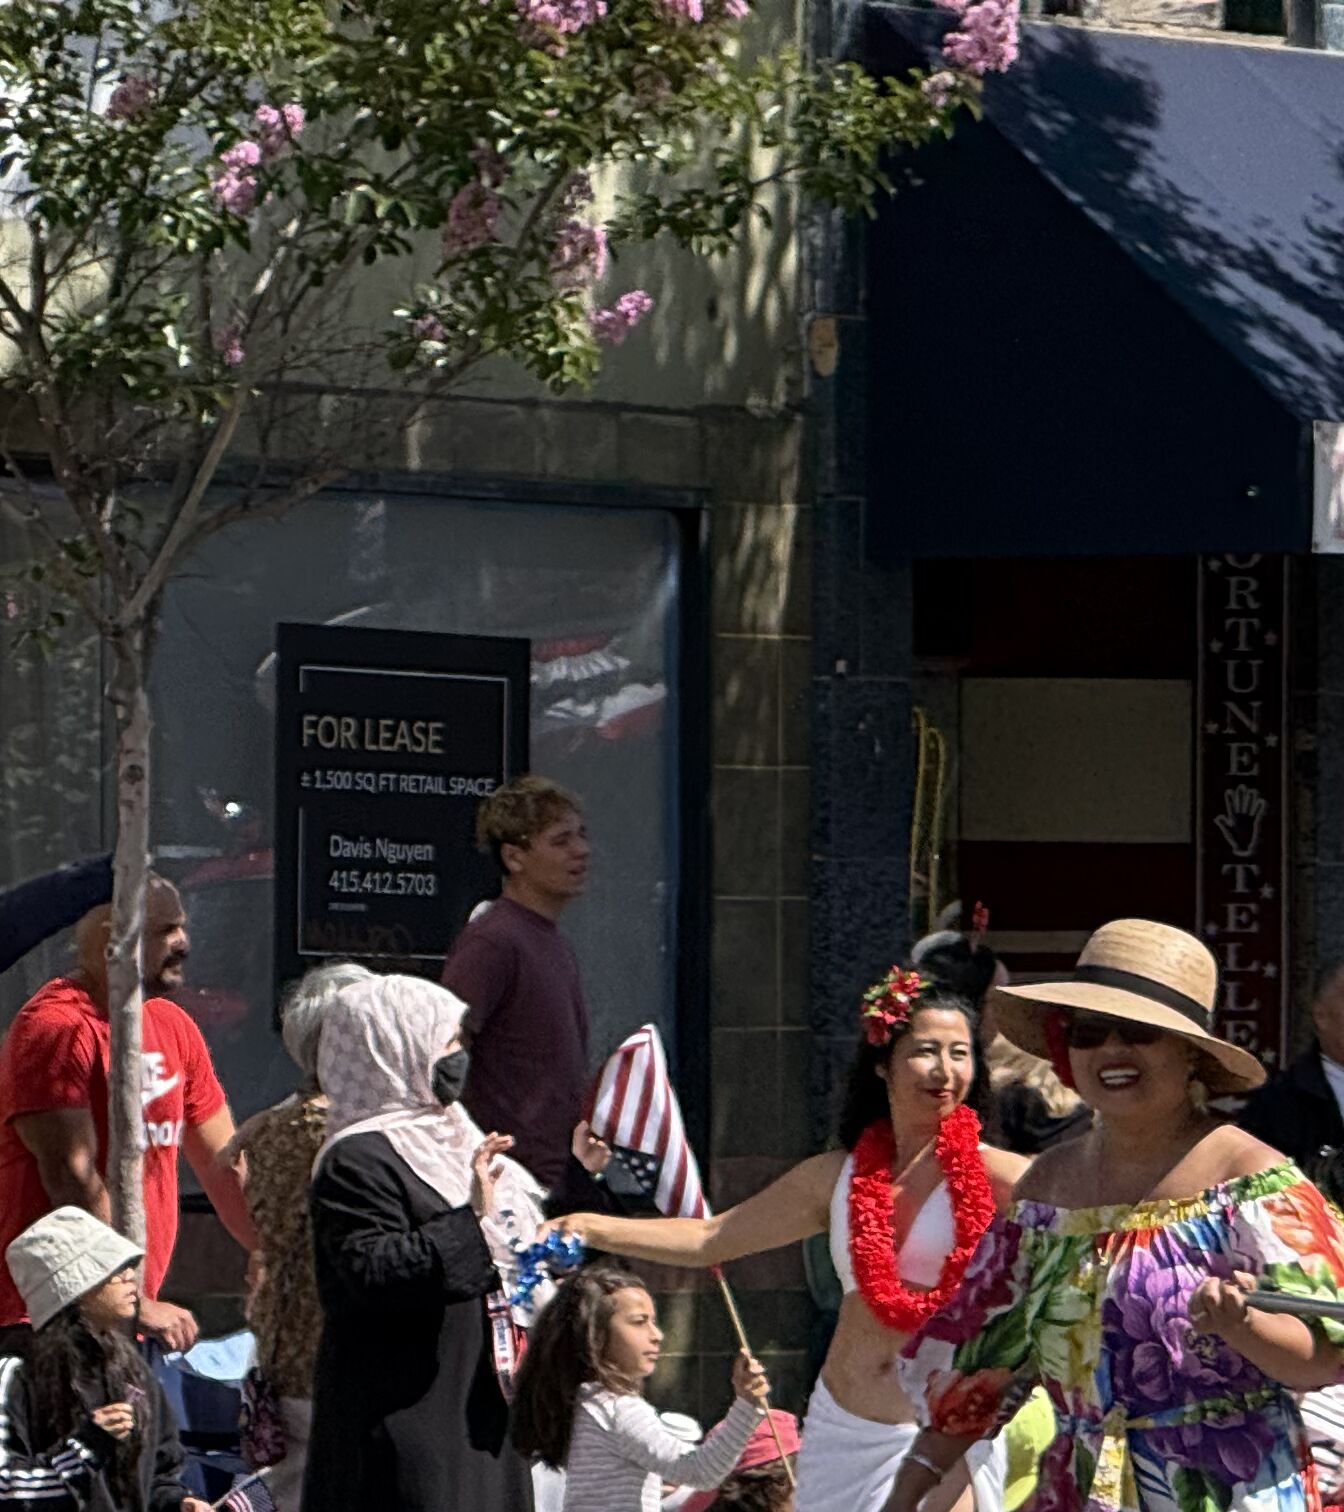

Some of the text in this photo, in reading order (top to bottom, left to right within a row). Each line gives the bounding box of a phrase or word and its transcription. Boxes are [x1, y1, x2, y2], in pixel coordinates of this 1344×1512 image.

[302, 715, 445, 754] FOR LEASE
[355, 774, 376, 794] SQ
[378, 775, 396, 792] FT
[399, 775, 447, 795] RETAIL
[449, 777, 495, 797] SPACE
[329, 835, 434, 864] Davis Nguyen
[329, 872, 436, 897] 415.412.5703
